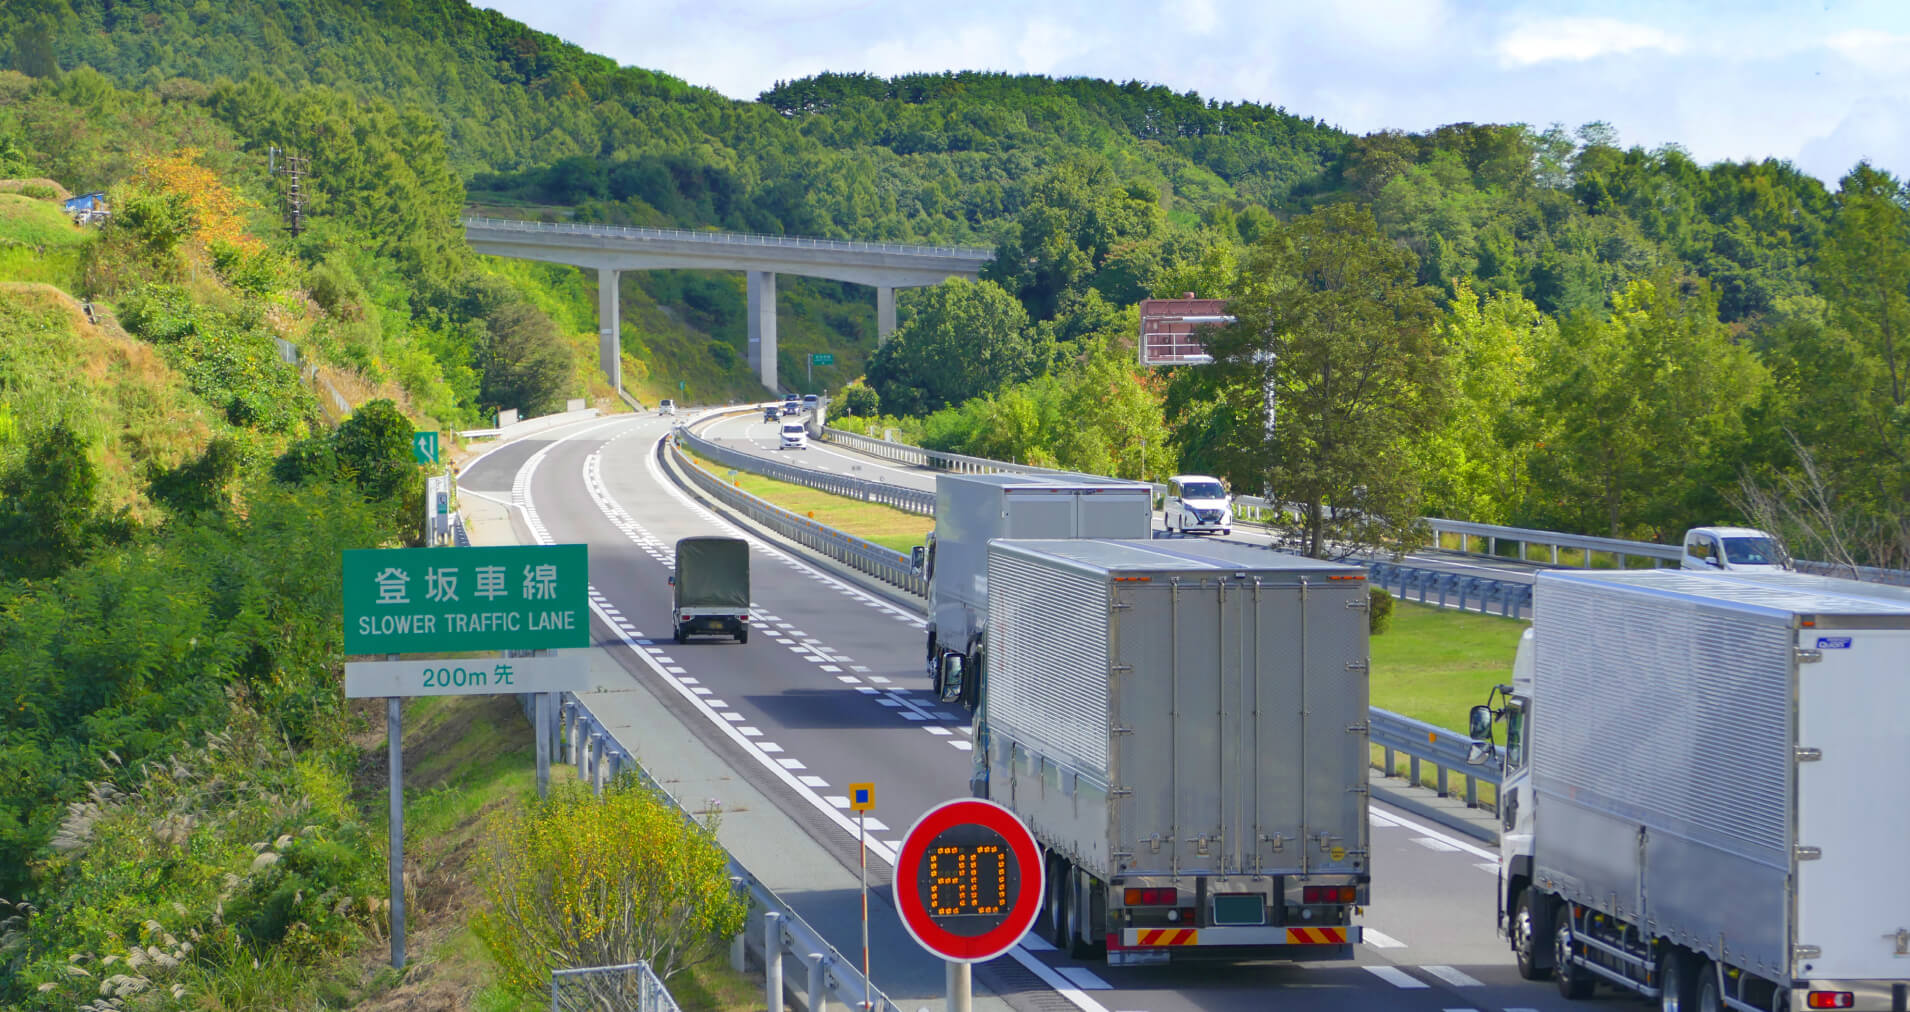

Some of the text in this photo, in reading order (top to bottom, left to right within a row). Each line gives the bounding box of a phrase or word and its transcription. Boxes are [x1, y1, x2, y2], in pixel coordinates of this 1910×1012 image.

[375, 564, 557, 604] 登坂車線
[359, 611, 575, 635] SLOWER TRAFFIC LANE
[930, 846, 1006, 914] 80
